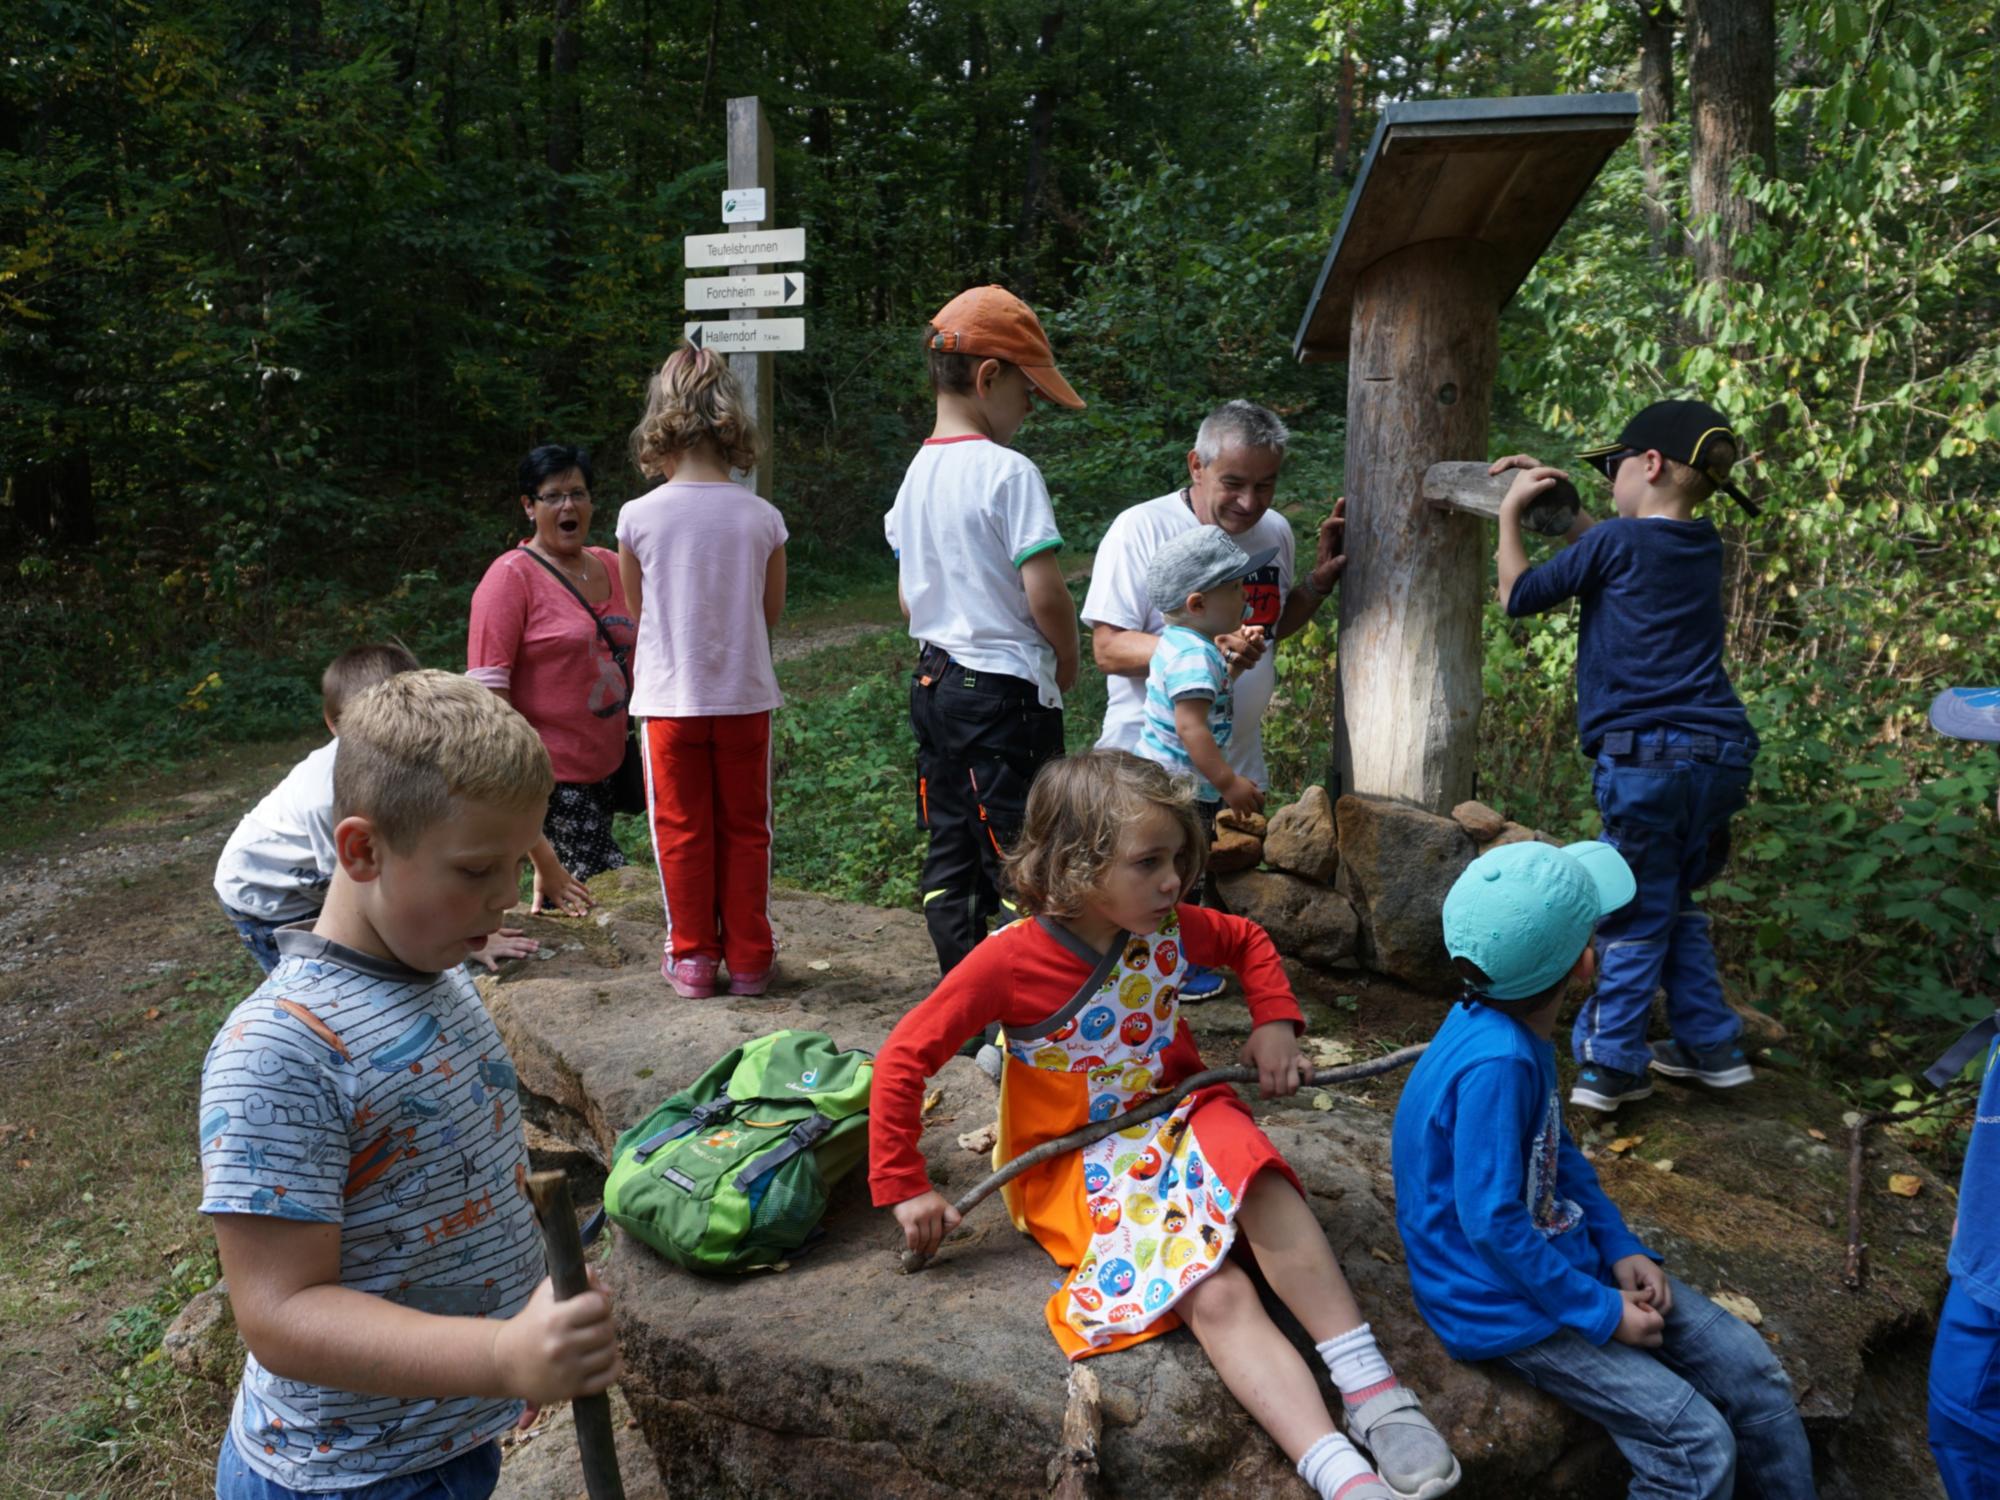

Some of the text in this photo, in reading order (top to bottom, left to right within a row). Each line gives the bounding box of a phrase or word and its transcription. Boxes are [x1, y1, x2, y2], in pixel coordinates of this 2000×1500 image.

[707, 241, 778, 257] Teufelsbrunnen
[706, 286, 756, 299] Forchheim
[706, 329, 757, 342] Hallerndorf
